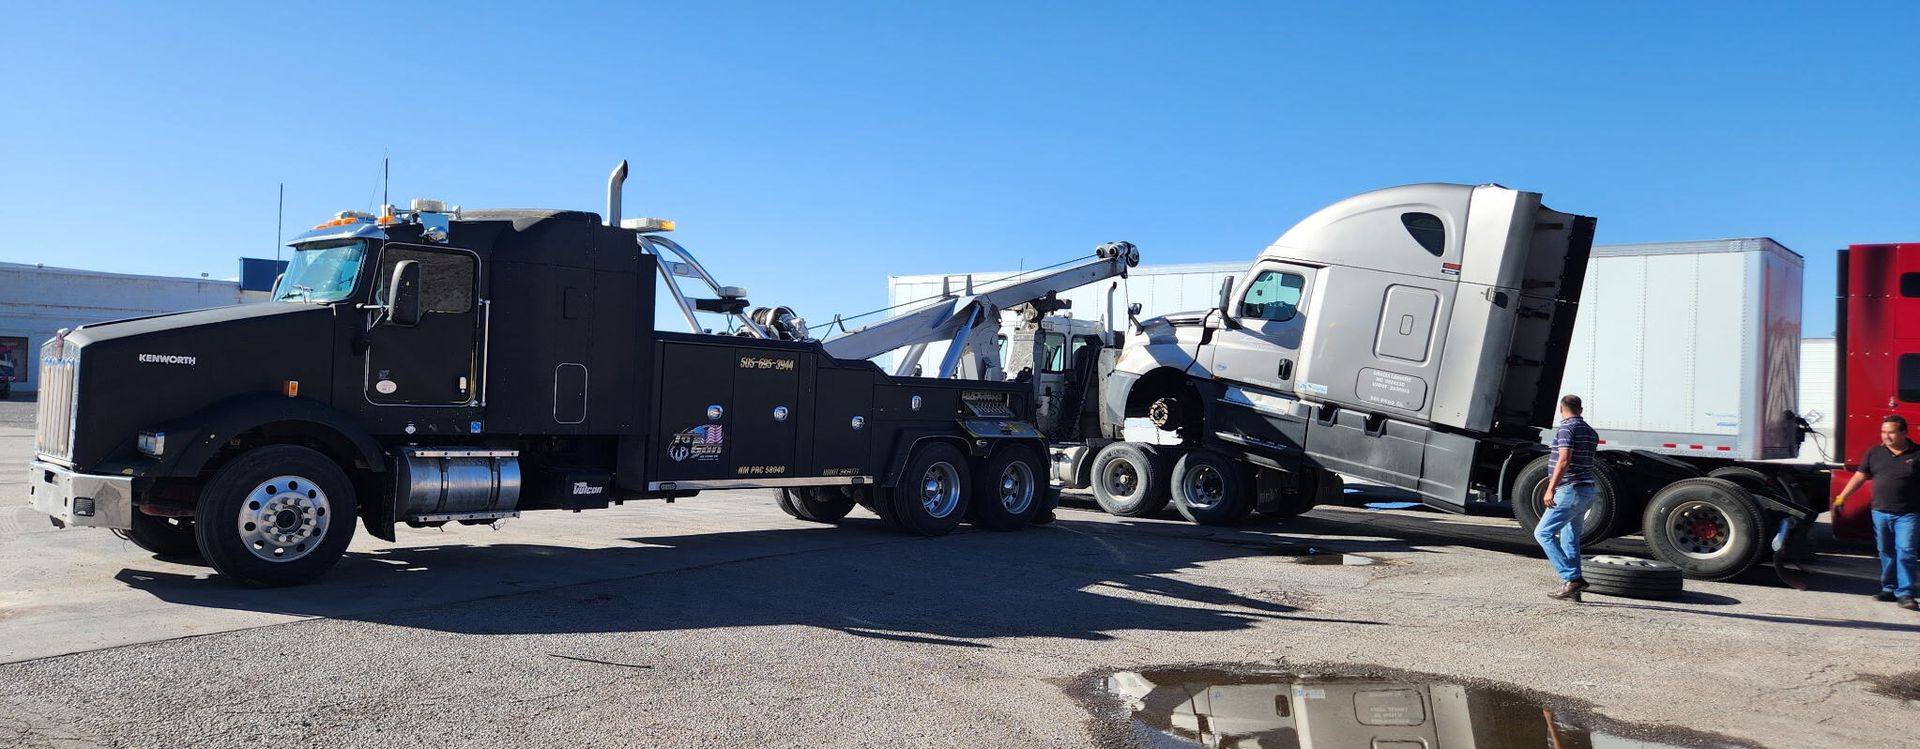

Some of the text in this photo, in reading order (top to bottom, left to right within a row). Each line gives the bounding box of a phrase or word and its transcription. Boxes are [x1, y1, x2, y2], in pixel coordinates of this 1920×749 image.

[139, 354, 196, 365] KENWORTH
[740, 357, 794, 370] 505-695-3944
[750, 465, 764, 474] PRC
